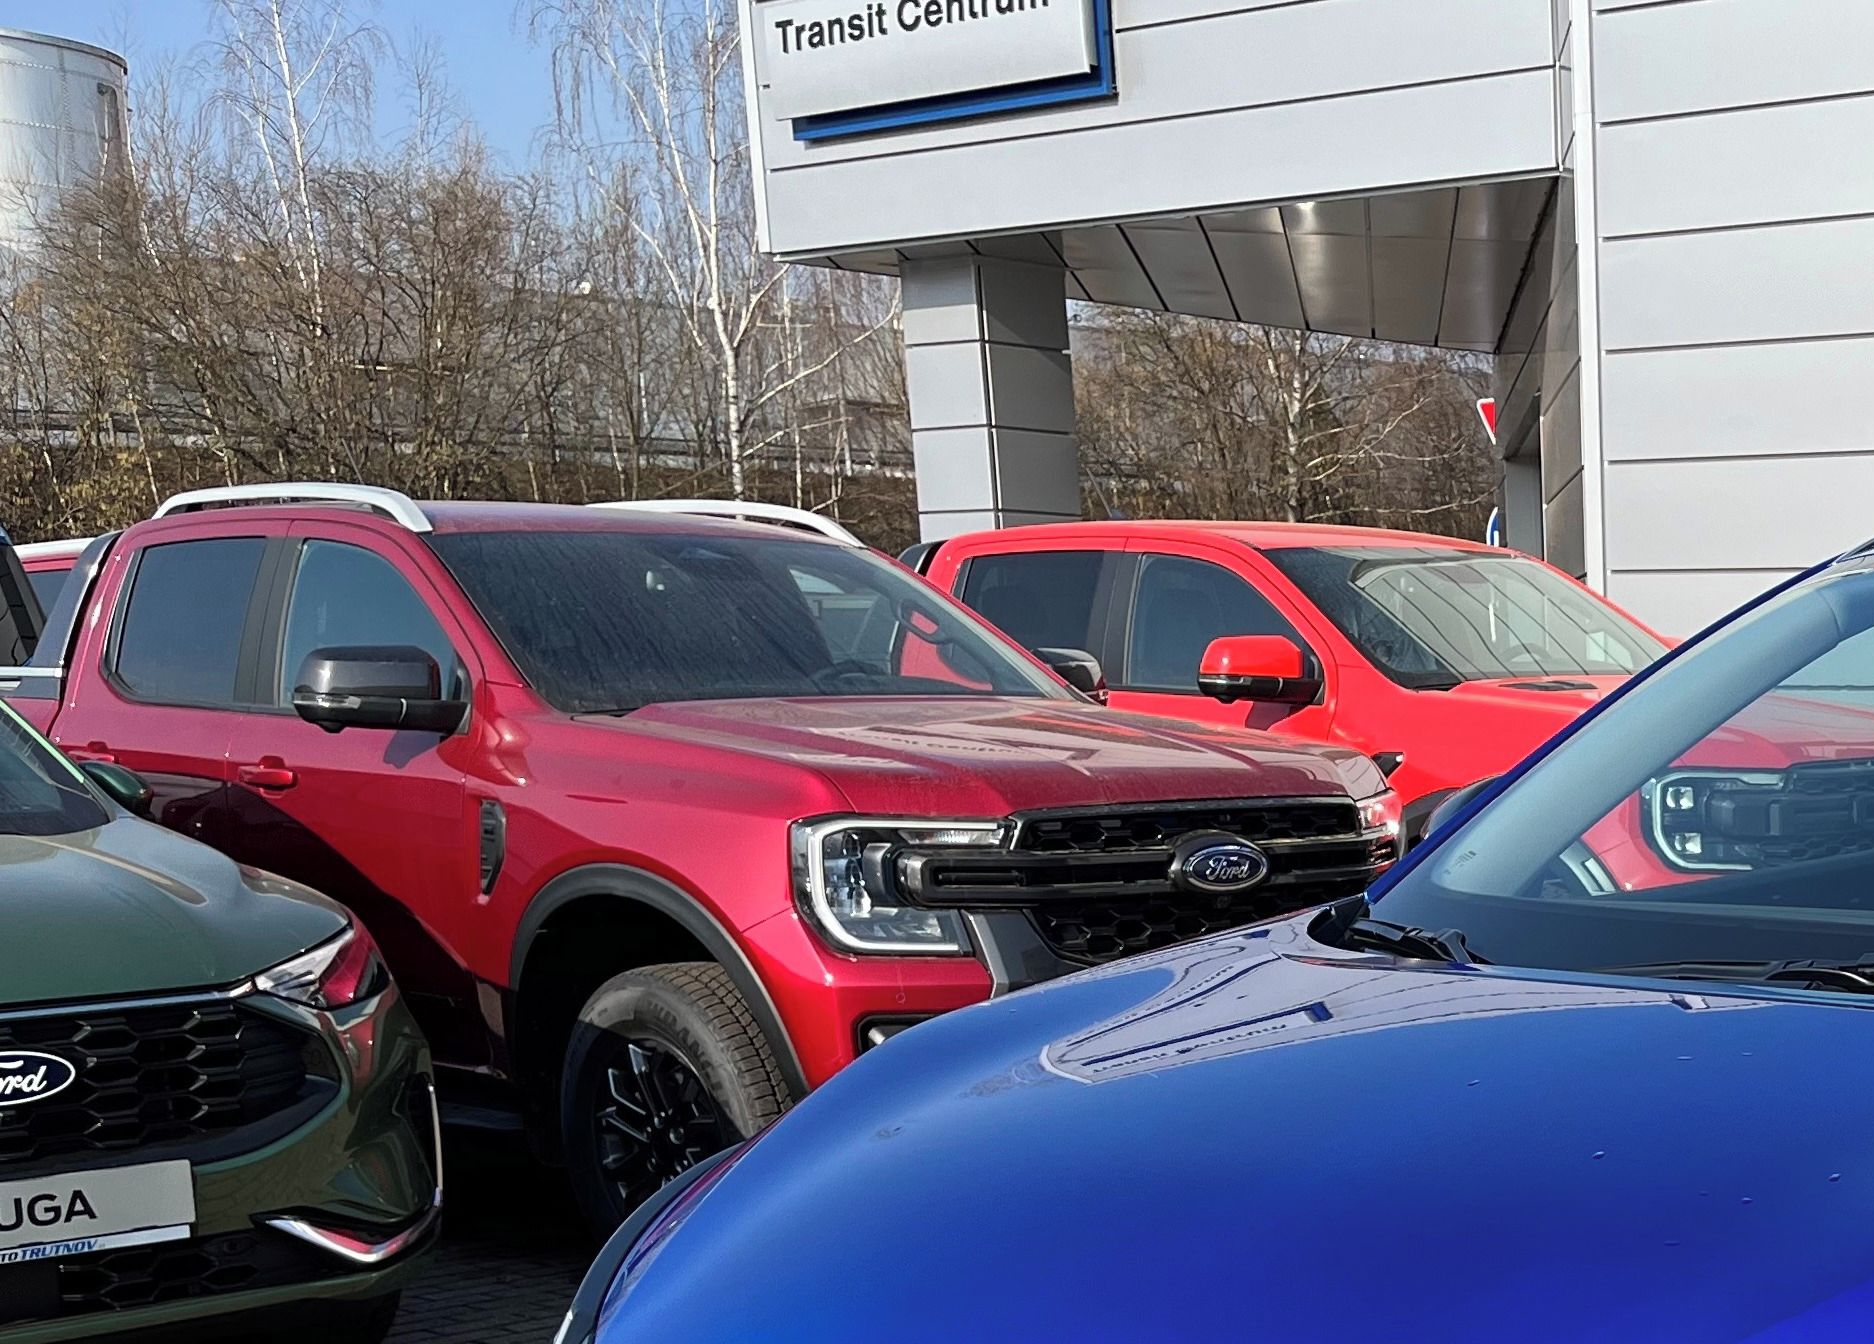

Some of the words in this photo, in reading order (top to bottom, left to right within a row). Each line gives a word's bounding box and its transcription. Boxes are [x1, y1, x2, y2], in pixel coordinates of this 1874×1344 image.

[775, 3, 888, 54] Transit
[1206, 855, 1250, 880] Ford
[21, 1239, 98, 1260] TRUTNOV
